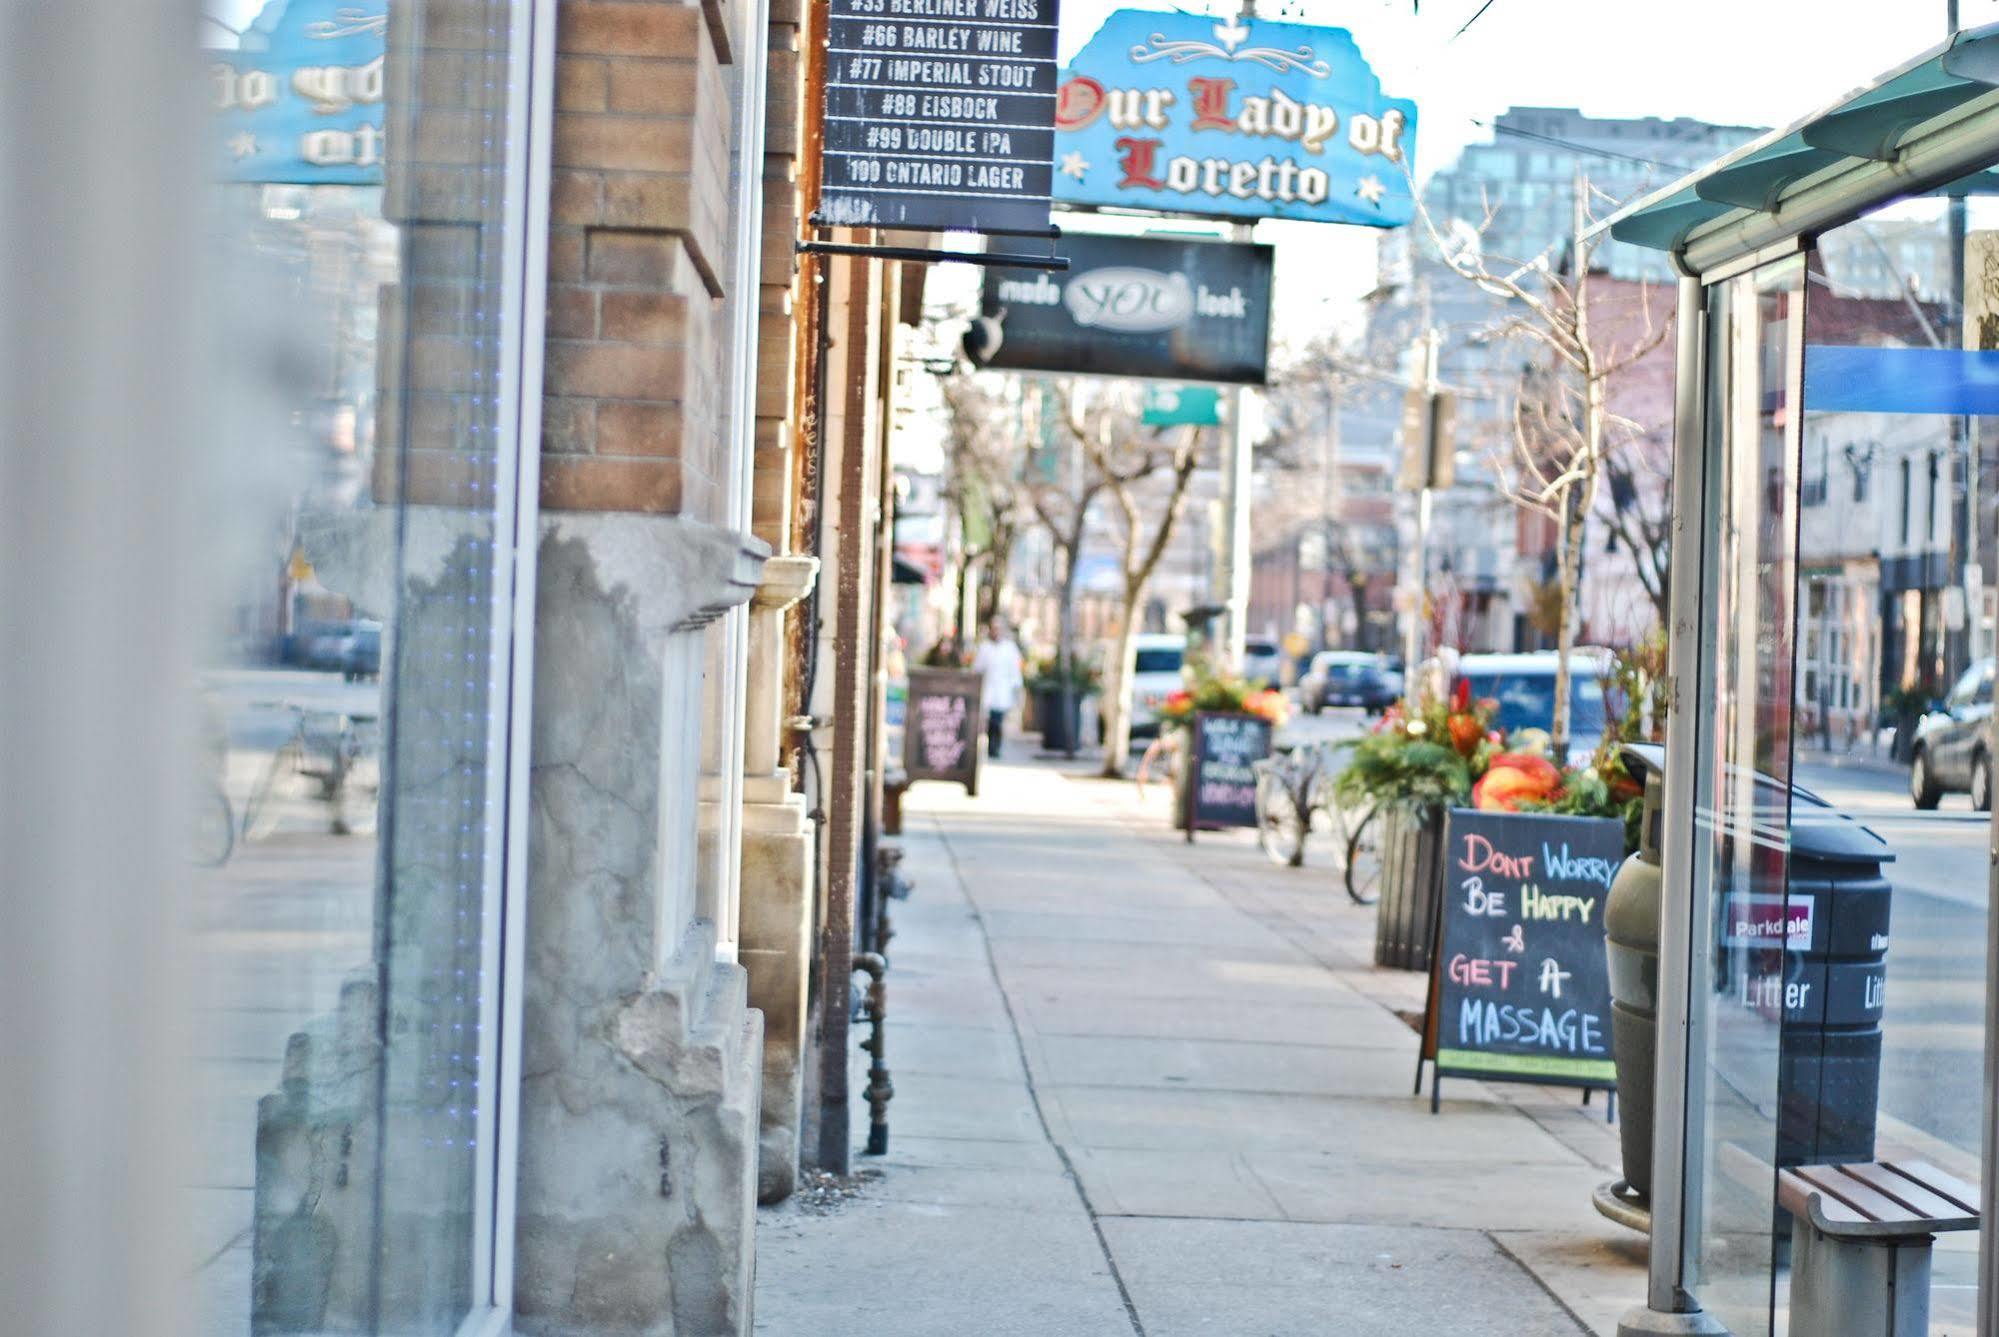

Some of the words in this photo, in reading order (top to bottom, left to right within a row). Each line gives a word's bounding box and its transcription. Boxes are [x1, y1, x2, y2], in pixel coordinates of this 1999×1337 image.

[890, 0, 977, 17] BERLINER
[984, 0, 1039, 20] WEISS
[862, 25, 897, 47] #66
[903, 26, 971, 50] BARLEY
[976, 31, 1023, 53] WINE
[850, 58, 882, 80] #77
[888, 60, 972, 85] IMPERIAL
[979, 64, 1036, 88] STOUT
[882, 93, 916, 116] #88
[922, 95, 998, 120] EISBOCK
[1055, 77, 1176, 132] Our
[1188, 77, 1340, 155] Lady
[1350, 109, 1405, 164] of
[867, 126, 902, 149] #99
[906, 128, 977, 153] DOUBLE
[982, 132, 1012, 155] IPA
[850, 160, 881, 183] 100
[886, 161, 962, 186] ONTARIO
[967, 165, 1024, 190] LAGER
[1115, 137, 1330, 205] Loretto
[1197, 284, 1246, 318] look
[1458, 833, 1535, 879] DONT
[1542, 841, 1619, 890] WORRY
[1461, 876, 1507, 917] BE
[1521, 883, 1595, 925] HAPPY
[1736, 917, 1809, 937] Parkdale
[1449, 953, 1518, 990] GET
[1538, 957, 1572, 999] A
[1742, 972, 1811, 1009] Litter
[1459, 997, 1605, 1052] MASSAGE
